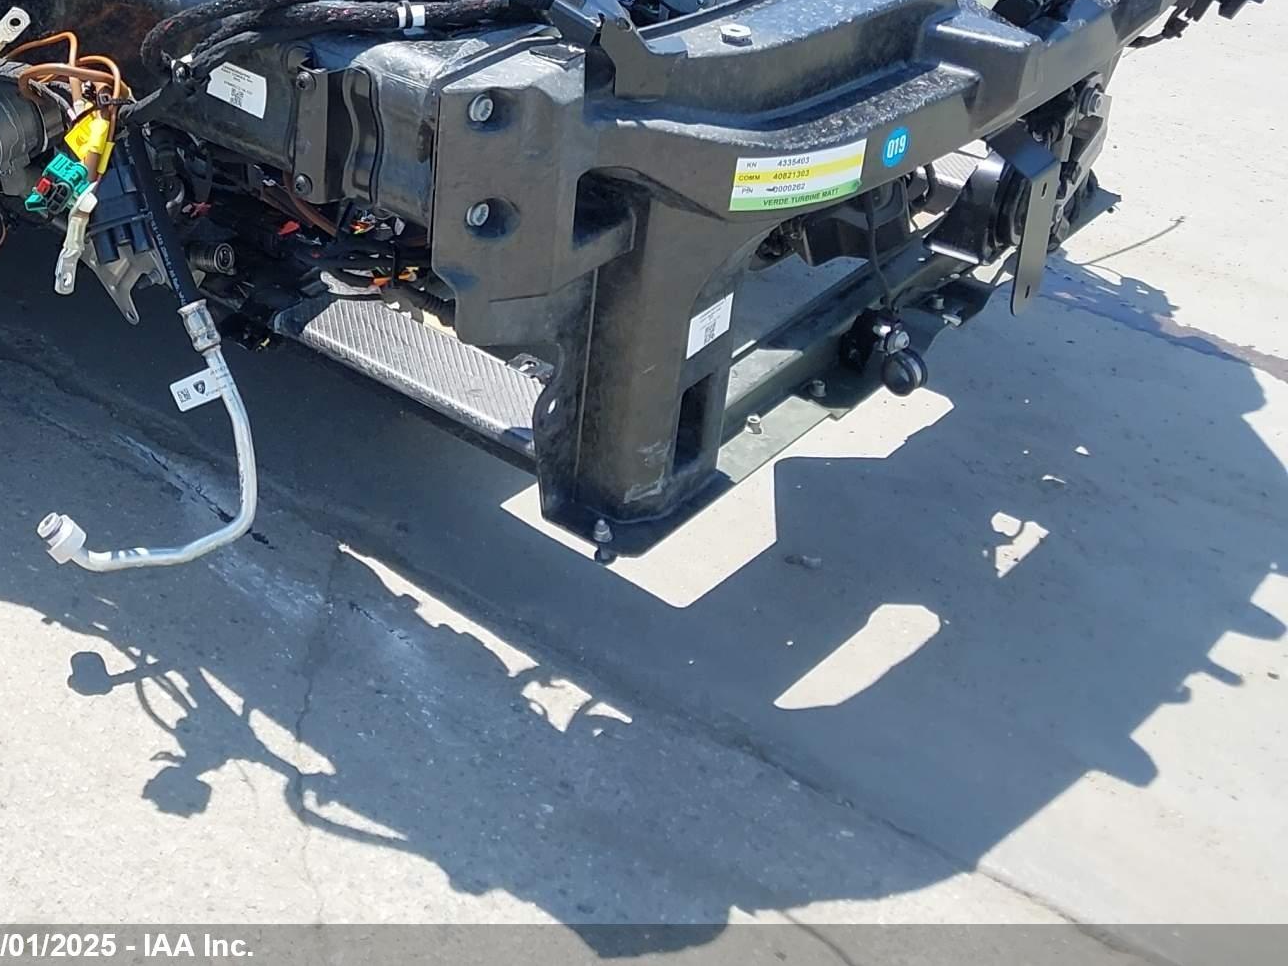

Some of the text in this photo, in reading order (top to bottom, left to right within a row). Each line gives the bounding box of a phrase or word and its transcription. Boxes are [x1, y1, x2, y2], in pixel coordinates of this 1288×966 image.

[886, 134, 907, 159] 019
[777, 156, 810, 167] 4335403
[738, 174, 761, 182] COMM
[763, 187, 839, 206] VERDE TURBINE MATT
